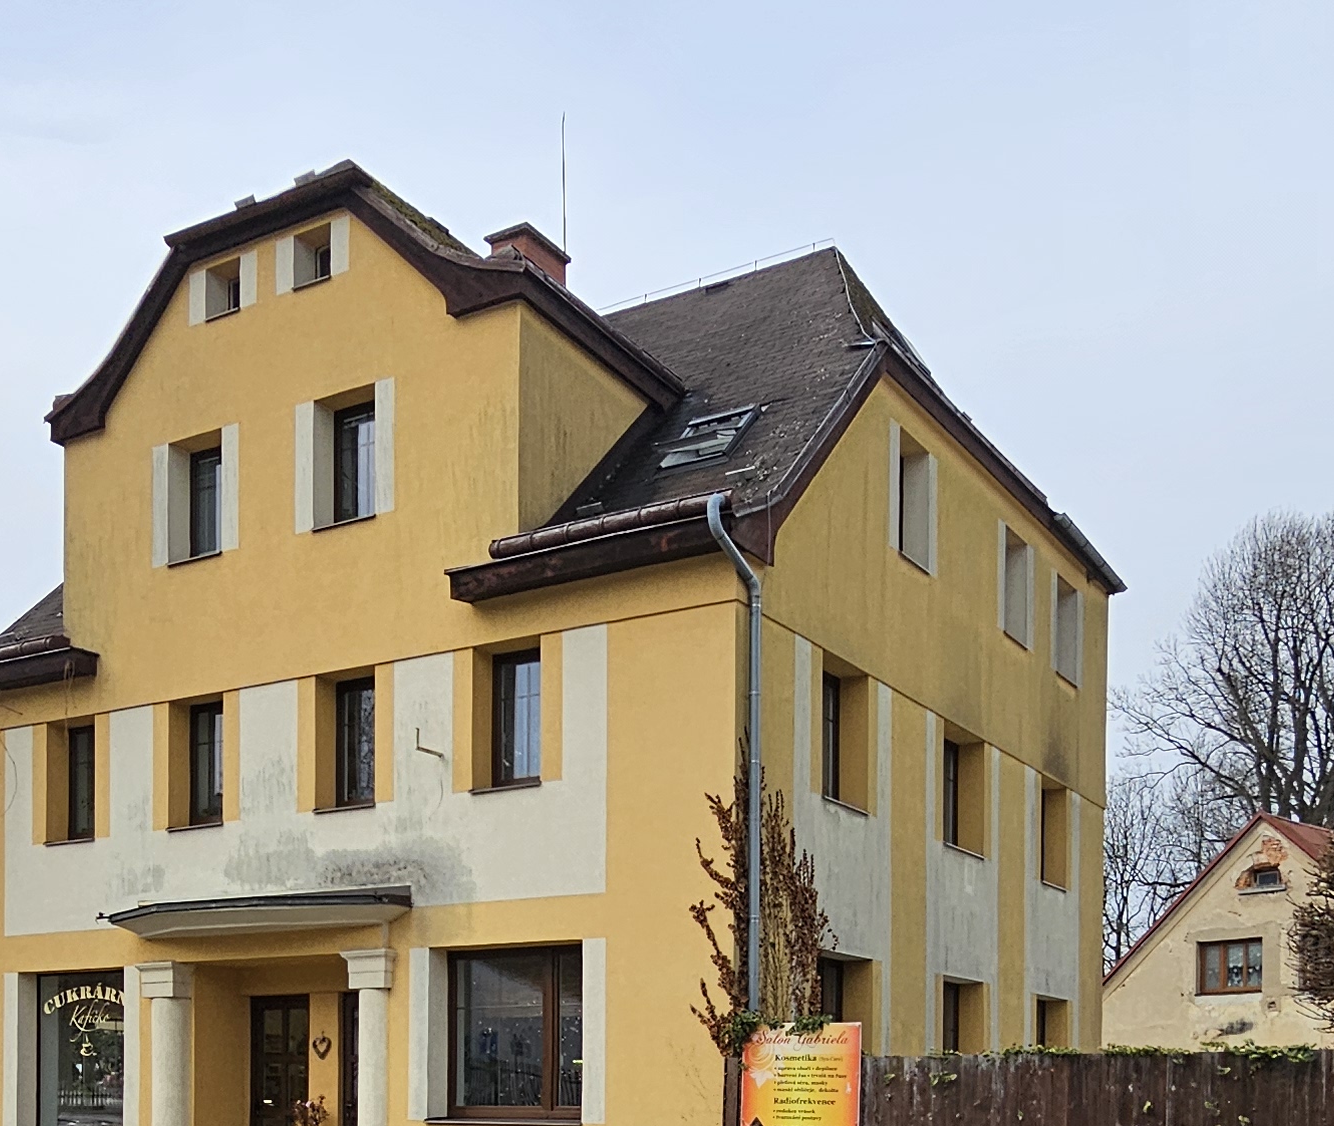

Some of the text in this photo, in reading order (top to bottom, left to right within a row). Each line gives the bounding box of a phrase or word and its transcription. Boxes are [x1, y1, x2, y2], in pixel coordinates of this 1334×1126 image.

[756, 1030, 848, 1051] Salon Gabriela
[773, 1097, 836, 1105] Radiofrekvence
